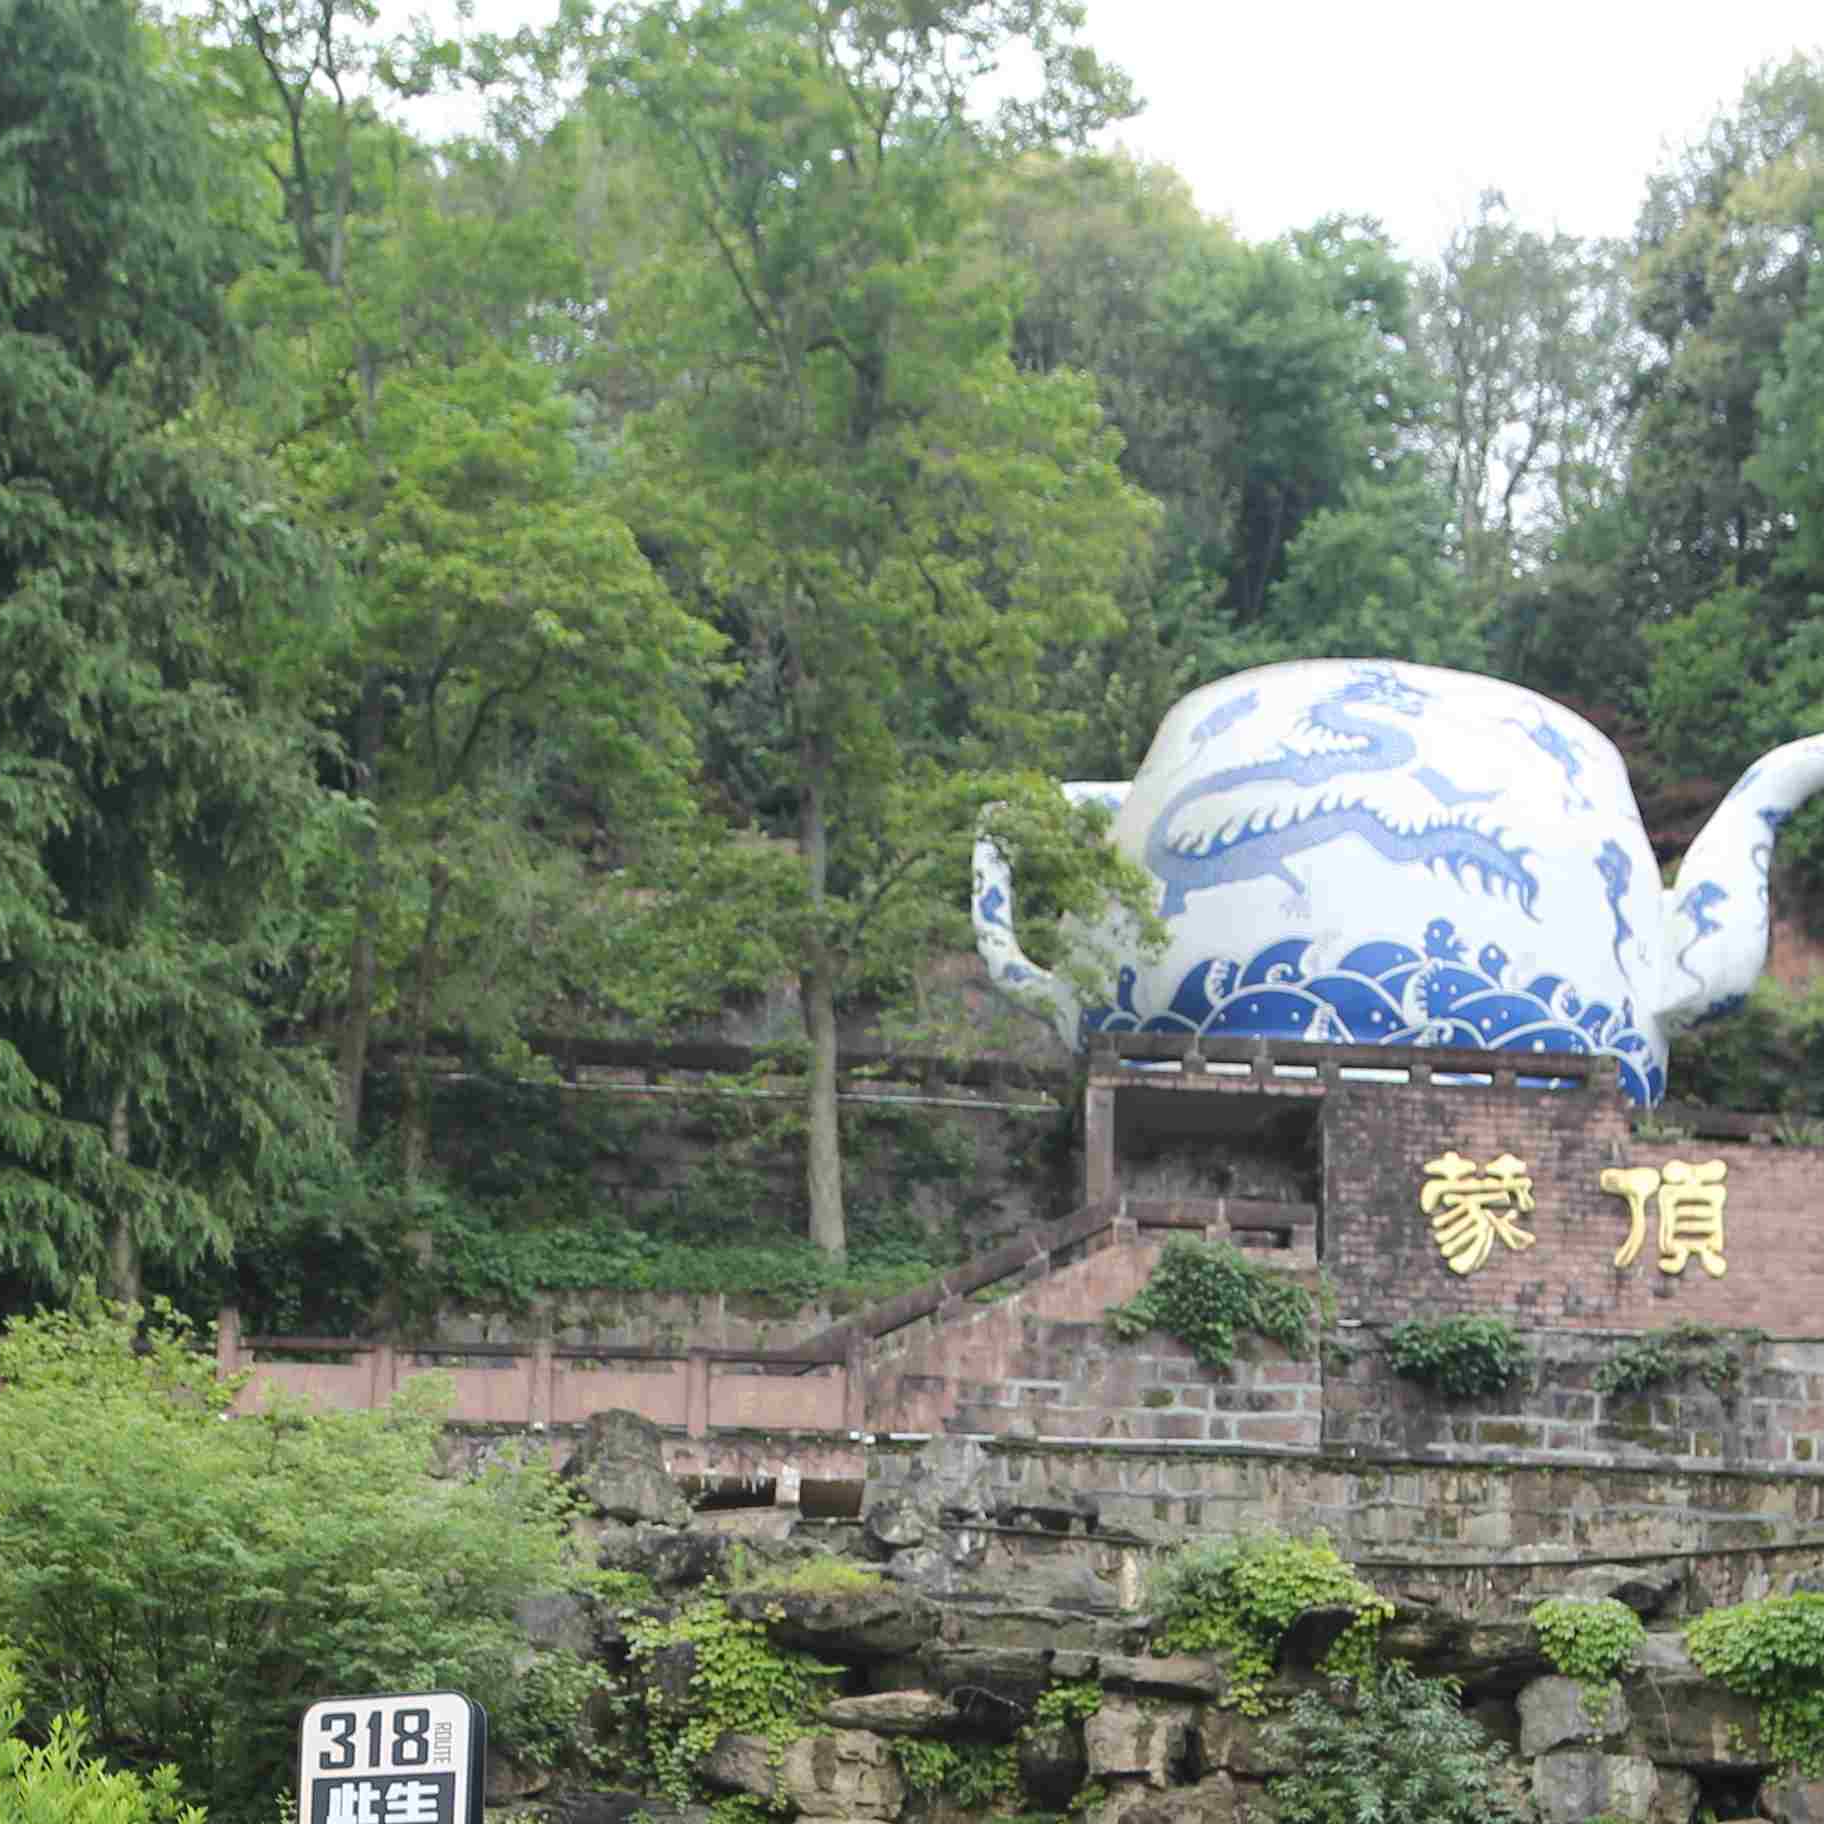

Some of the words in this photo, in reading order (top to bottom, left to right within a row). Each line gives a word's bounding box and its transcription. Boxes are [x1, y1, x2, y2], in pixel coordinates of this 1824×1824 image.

[1421, 1152, 1727, 1278] 蒙頂
[319, 1708, 430, 1770] 318
[434, 1721, 452, 1764] ROUTE
